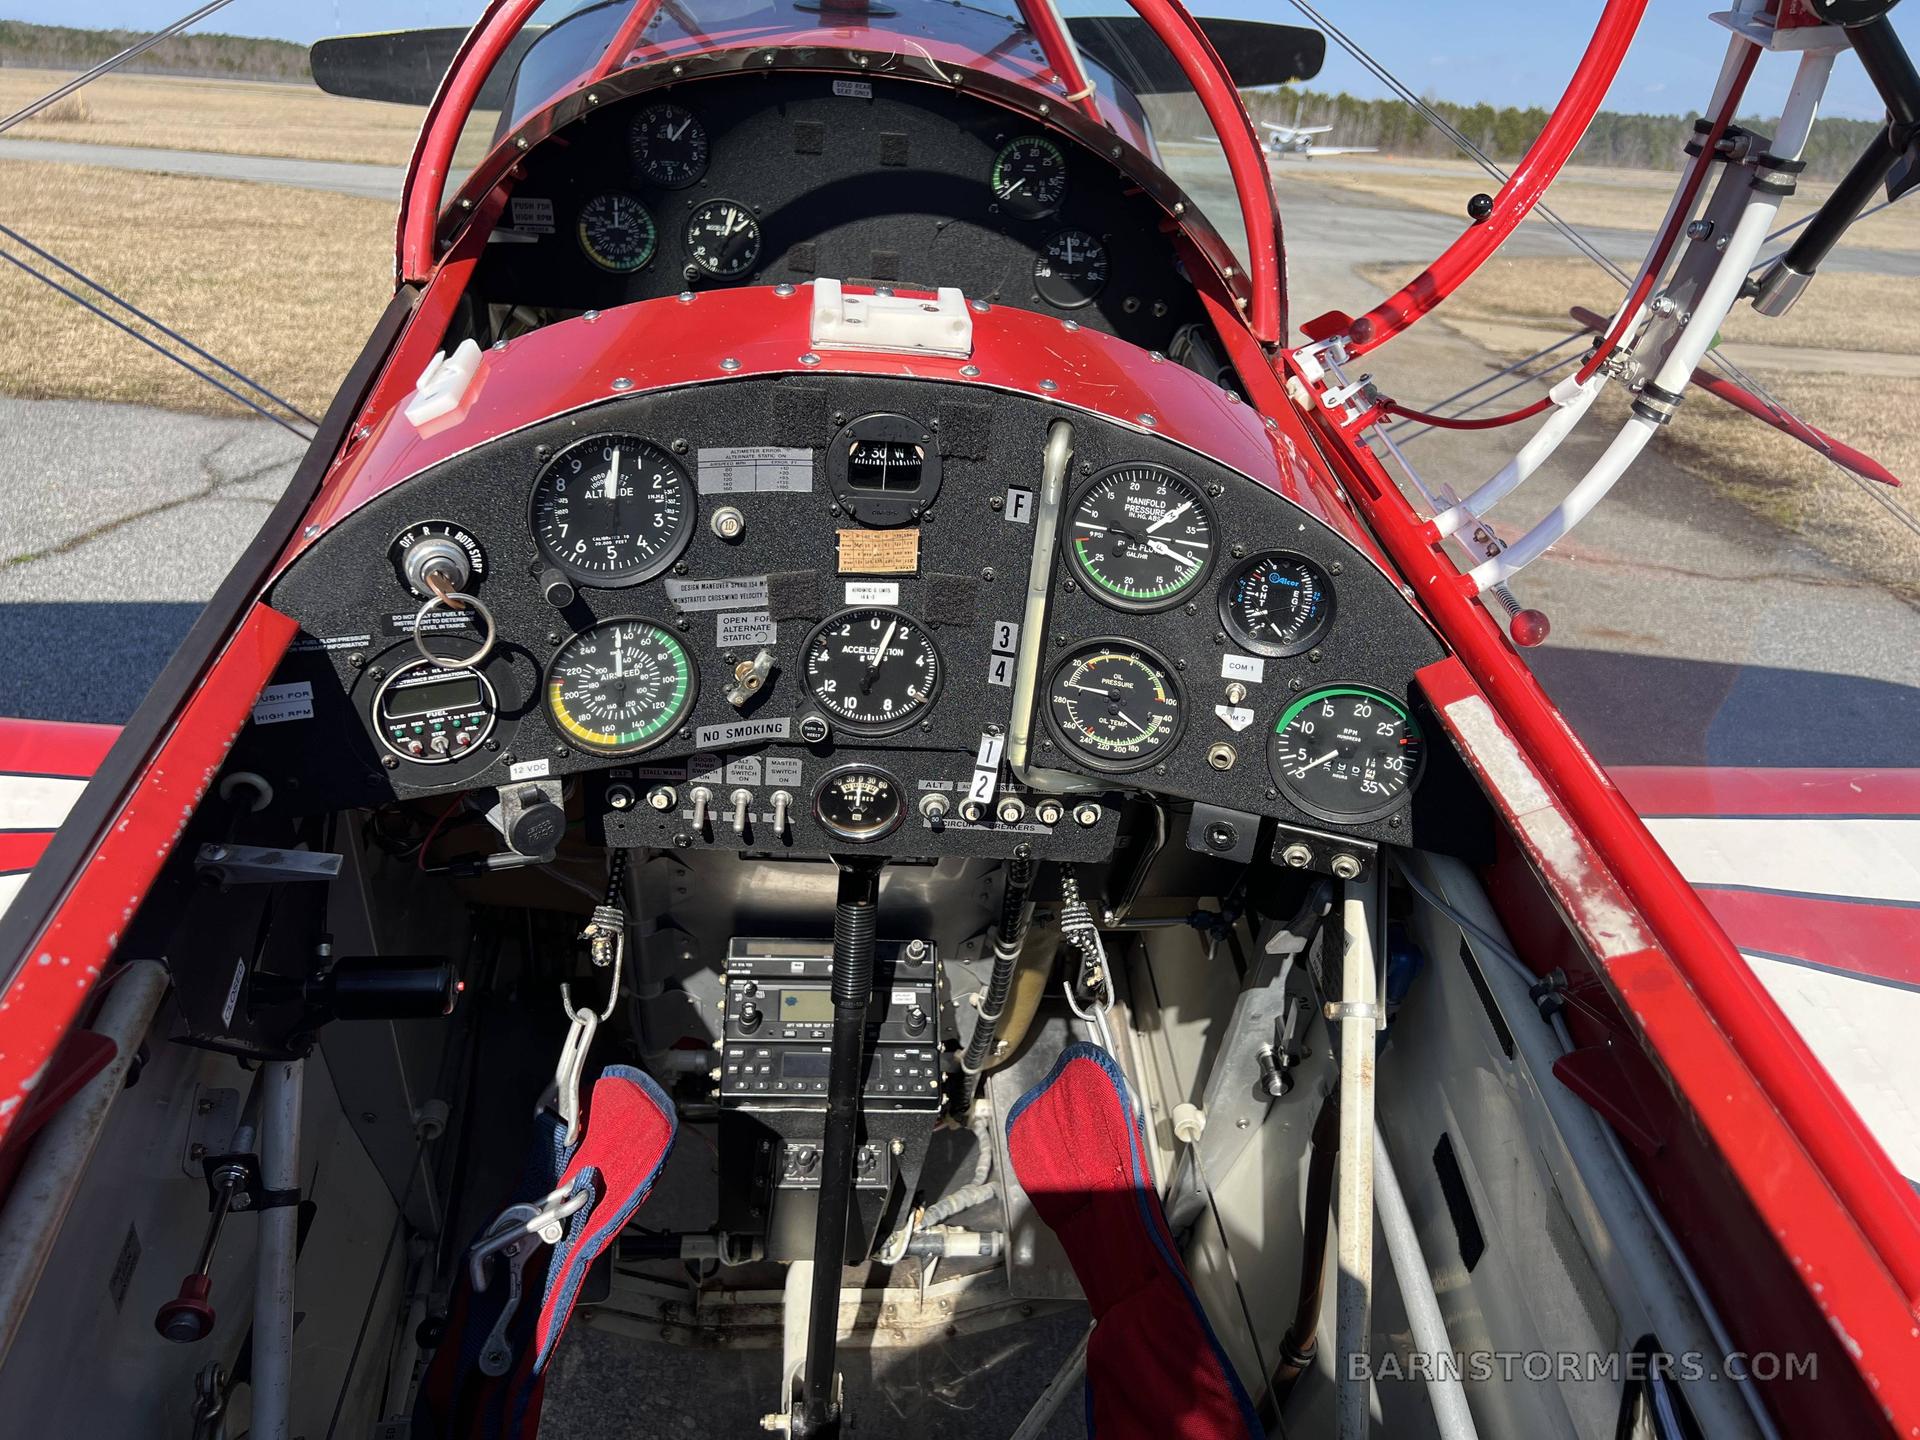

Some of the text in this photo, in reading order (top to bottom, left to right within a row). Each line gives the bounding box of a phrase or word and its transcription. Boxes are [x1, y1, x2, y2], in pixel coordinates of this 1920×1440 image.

[649, 114, 656, 123] 9
[666, 110, 673, 119] 0
[642, 123, 648, 132] 8
[691, 129, 698, 138] 2
[651, 160, 658, 169] 6
[667, 166, 674, 175] 5
[737, 212, 745, 222] 2
[603, 447, 612, 461] 0
[871, 449, 887, 458] 30
[571, 460, 582, 474] 9
[556, 478, 566, 492] 8
[653, 474, 662, 489] 2
[1129, 483, 1140, 491] 20
[1156, 487, 1167, 495] 25
[585, 488, 634, 499] ALTDE
[1013, 494, 1025, 518] F
[1126, 496, 1166, 509] MANIFOLD
[1124, 504, 1166, 517] PRESSURE
[653, 513, 664, 527] 3
[422, 526, 431, 536] R
[444, 526, 450, 536] L
[558, 524, 569, 538] 7
[1185, 526, 1196, 534] 35
[399, 533, 415, 548] OFF
[454, 531, 476, 550] BOTH
[637, 534, 649, 548] 4
[575, 539, 587, 553] 6
[607, 545, 618, 559] 5
[1094, 553, 1105, 561] 25
[469, 548, 483, 574] START
[1174, 565, 1182, 573] 10
[1124, 576, 1134, 584] 20
[1155, 576, 1163, 584] 15
[723, 616, 748, 624] OPEN
[871, 618, 880, 630] 0
[723, 624, 771, 634] ALTERNATE
[900, 627, 909, 639] 2
[723, 633, 752, 642] STATIC
[1000, 626, 1010, 648] 3
[580, 646, 596, 655] 240
[915, 655, 925, 667] 4
[1072, 659, 1082, 667] 20
[995, 660, 1006, 682] 4
[1229, 662, 1248, 671] COM
[566, 668, 582, 676] 220
[600, 670, 641, 681] AIRSEED
[824, 680, 837, 692] 12
[1101, 679, 1134, 689] PRESSURE
[288, 691, 310, 700] FOR
[564, 691, 579, 699] 200
[907, 685, 916, 696] 6
[844, 697, 858, 709] 10
[1053, 695, 1067, 704] 280
[1165, 698, 1178, 706] 100
[883, 699, 893, 711] 8
[257, 709, 311, 721] HIGH RPM
[1322, 704, 1335, 718] 15
[1353, 704, 1372, 718] 20
[578, 714, 592, 722] 180
[1098, 717, 1109, 725] OIL
[1162, 714, 1173, 722] 40
[1063, 722, 1076, 730] 260
[1158, 726, 1171, 734] 100
[1301, 721, 1315, 734] 10
[1376, 722, 1395, 736] 25
[703, 723, 783, 742] NO SMOKING
[1343, 727, 1358, 736] RPM
[1079, 736, 1093, 744] 240
[1147, 736, 1159, 744] 140
[1096, 743, 1110, 751] 220
[1113, 745, 1127, 753] 200
[986, 741, 994, 764] 1
[1298, 748, 1307, 761] 5
[528, 763, 547, 772] VDC
[1384, 757, 1403, 771] 30
[975, 777, 989, 799] 2
[1360, 780, 1378, 794] 35
